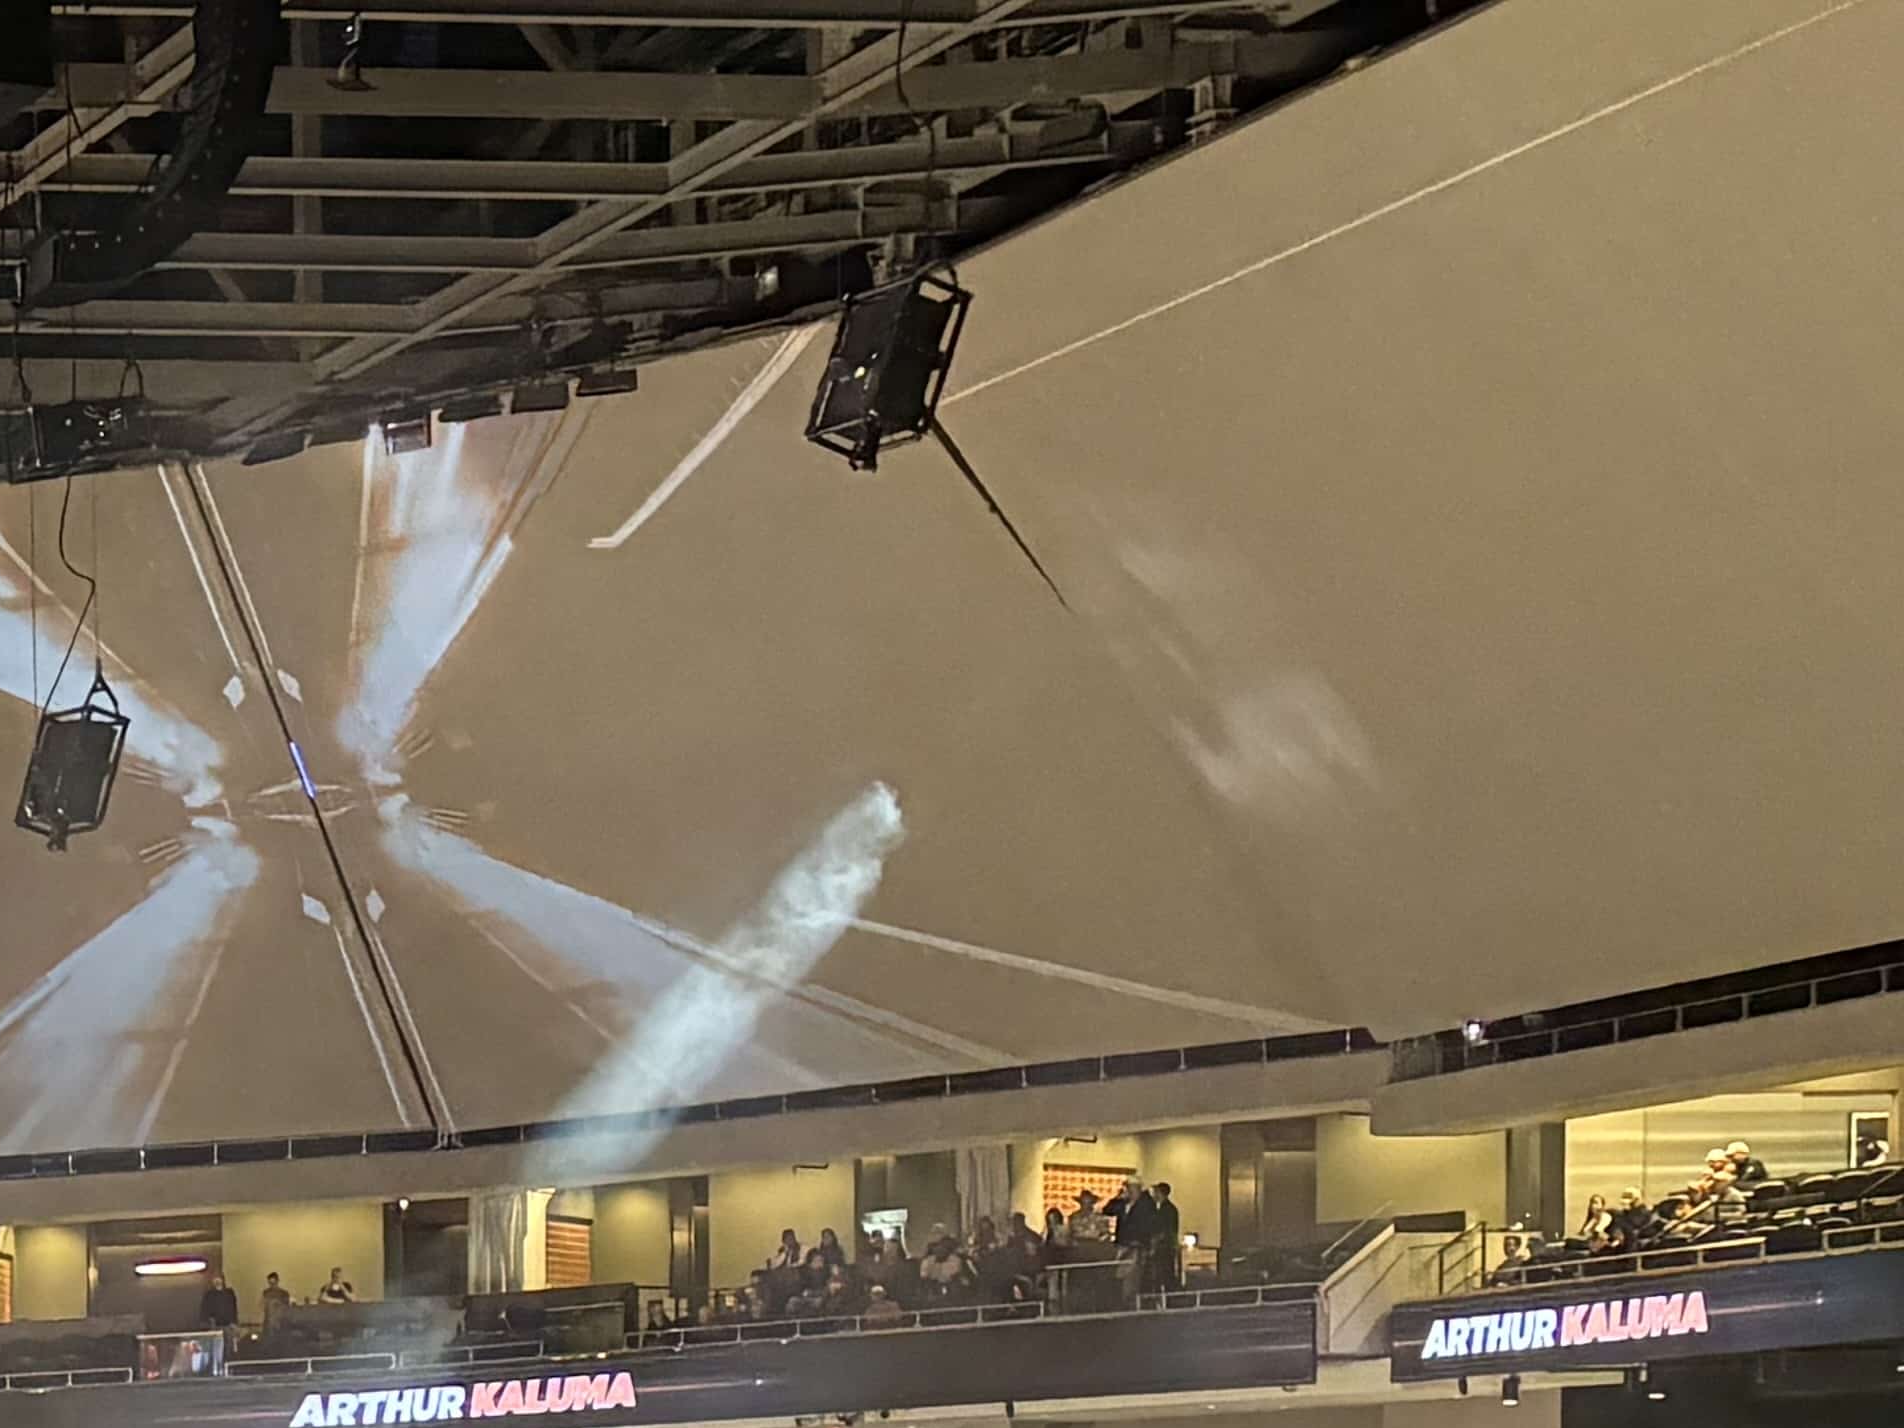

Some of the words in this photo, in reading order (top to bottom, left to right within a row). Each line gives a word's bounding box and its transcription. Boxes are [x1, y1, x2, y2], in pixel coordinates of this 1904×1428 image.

[1420, 1307, 1558, 1360] ARTHUR
[1560, 1290, 1709, 1347] KALUMA
[289, 1384, 468, 1428] ARTHUR
[469, 1371, 637, 1418] KALUMA
